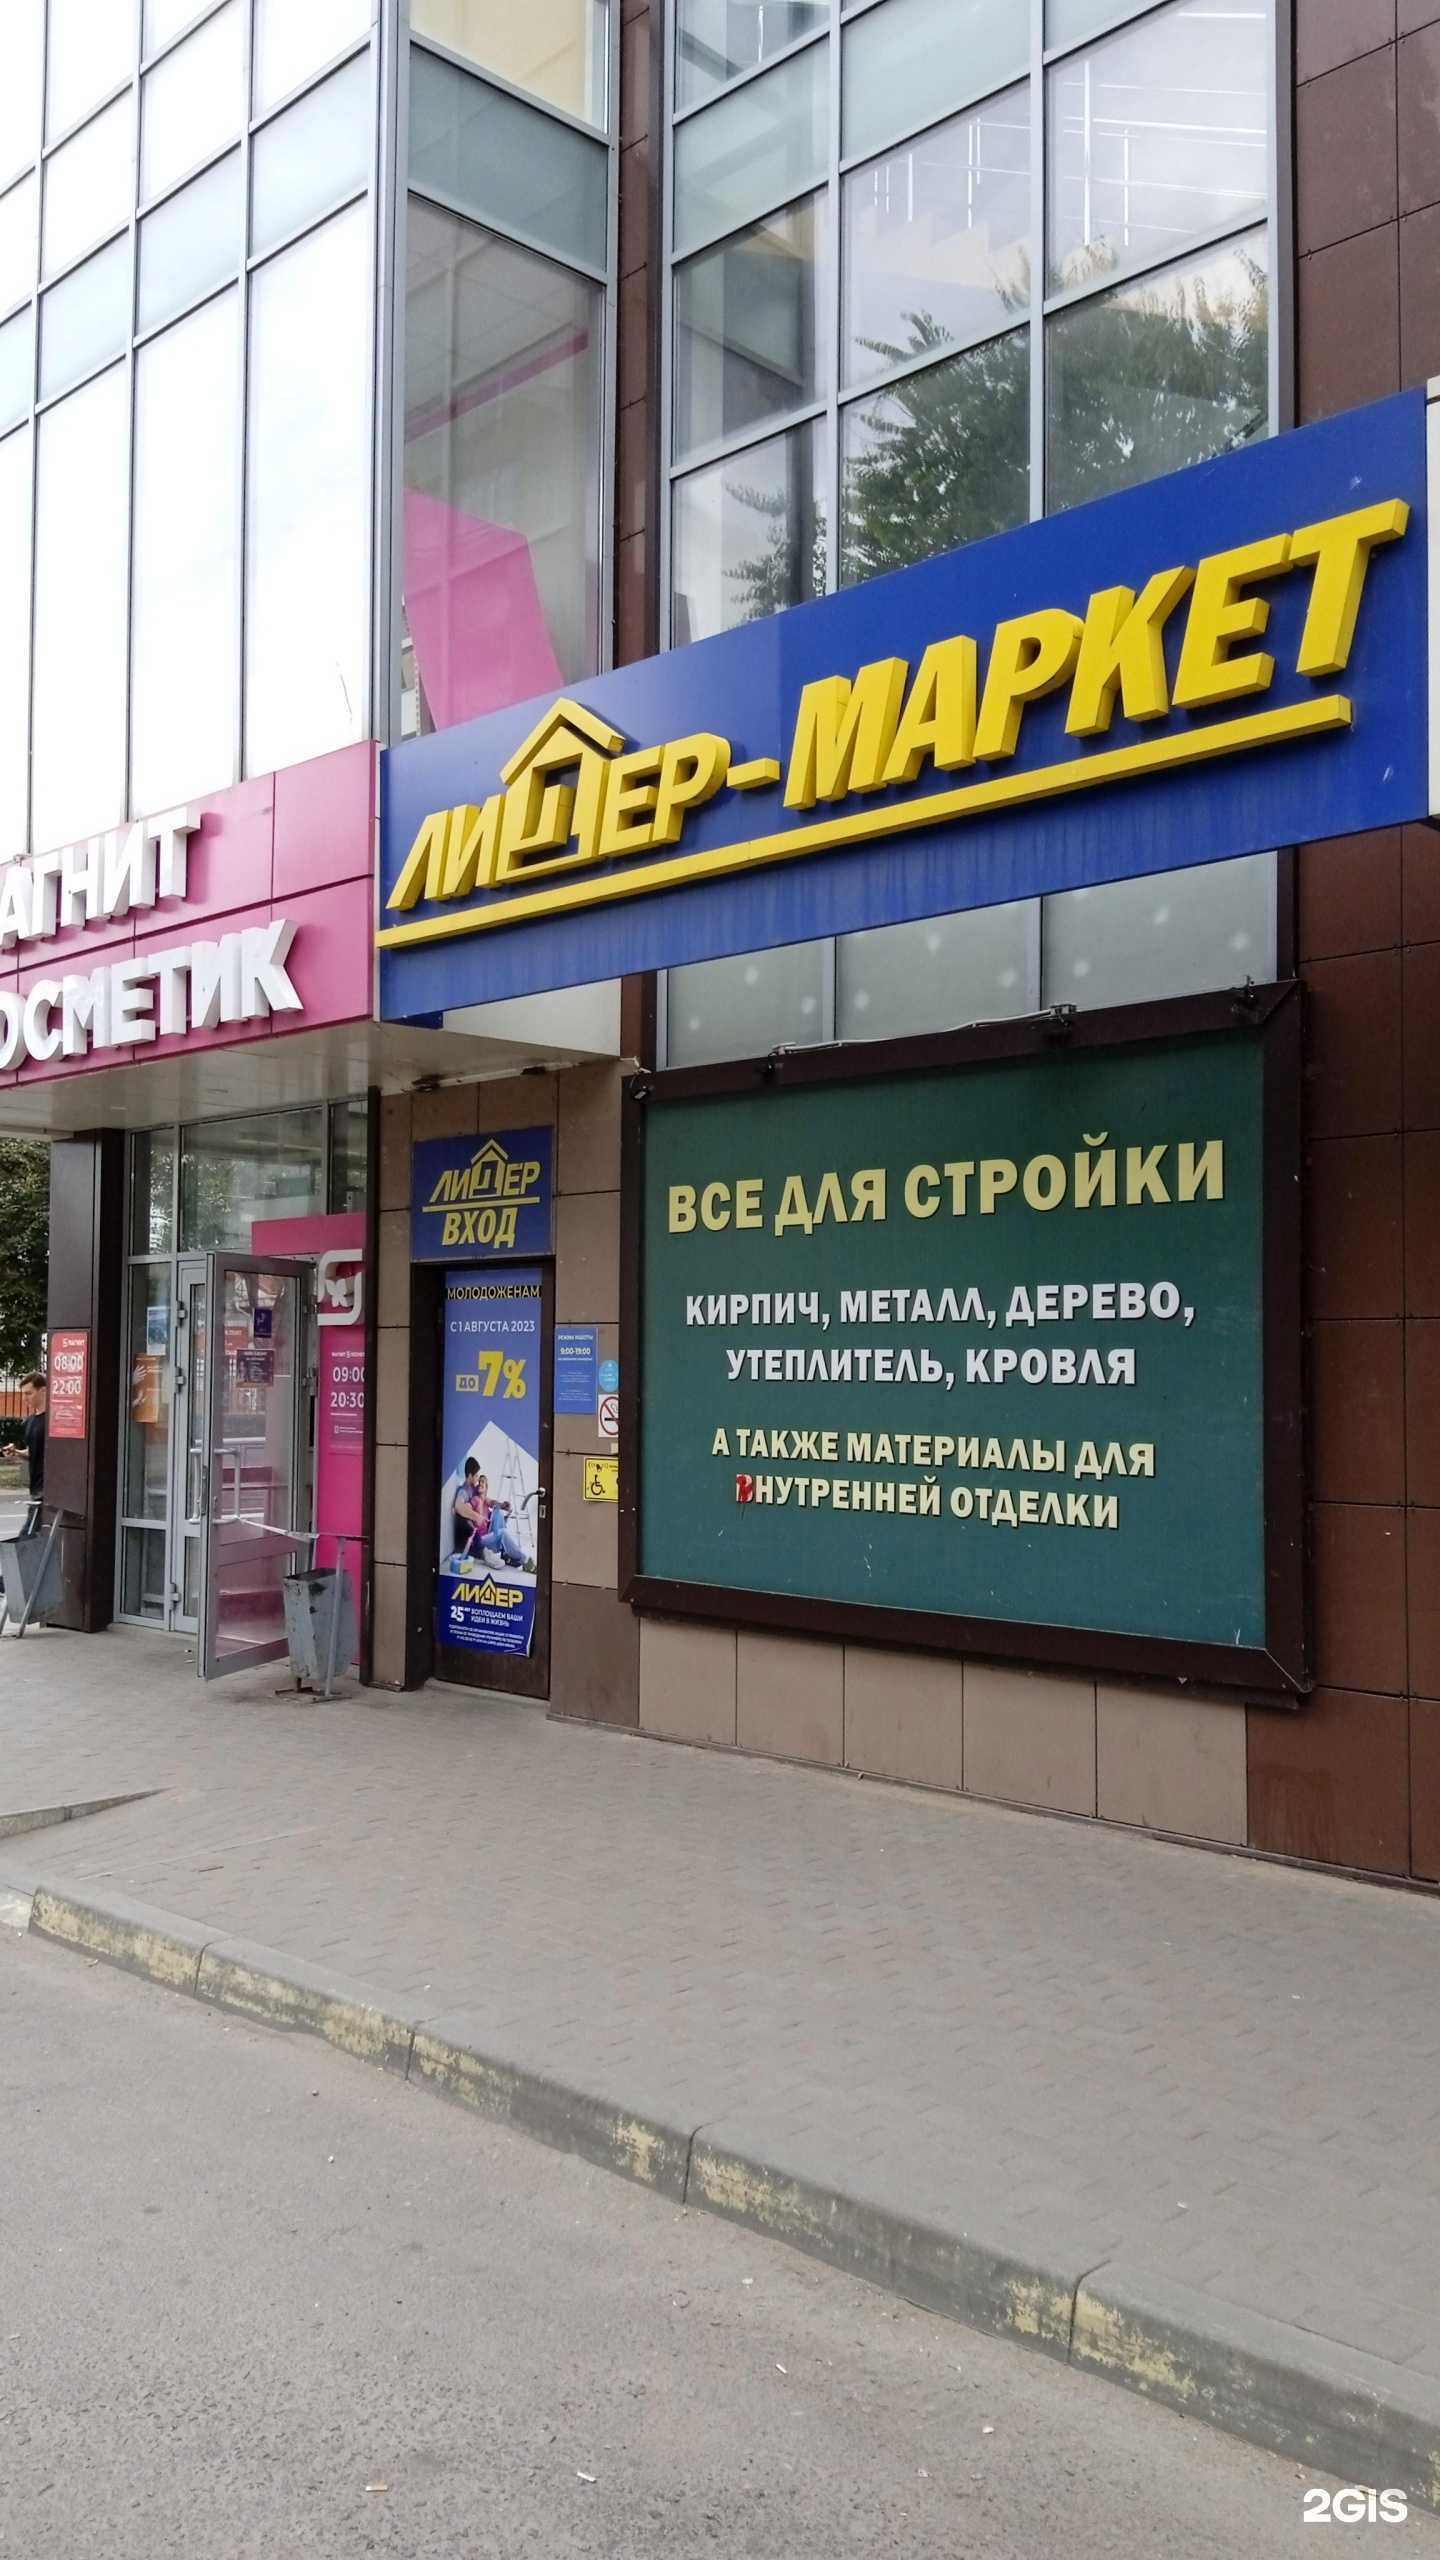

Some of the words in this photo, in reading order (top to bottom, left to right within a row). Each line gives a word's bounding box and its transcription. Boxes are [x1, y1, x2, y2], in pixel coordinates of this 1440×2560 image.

[429, 1139, 541, 1203] ЛИДЕР
[668, 1179, 764, 1233] ВСЕ
[774, 1168, 886, 1236] ДЛЯ
[904, 1132, 1225, 1218] СТРОЙКИ
[442, 1208, 518, 1248] ВХОД
[447, 1285, 540, 1301] МОЛОДОЖЕНАМ
[686, 1291, 831, 1330] КИРПИЧ,
[840, 1287, 997, 1329] МЕТАЛЛ,
[1005, 1281, 1196, 1328] ДЕРЕВО,
[464, 1320, 510, 1333] АВГУСТА
[511, 1320, 536, 1333] 2023
[54, 1354, 84, 1371] 08:00
[458, 1377, 477, 1390] ДО
[477, 1350, 527, 1399] 7%
[726, 1348, 954, 1391] УТЕПЛИТЕЛЬ,
[966, 1348, 1137, 1385] КРОВЛЯ
[330, 1391, 365, 1408] 20:30
[712, 1428, 730, 1456] А
[736, 1428, 839, 1462] ТАКЖЕ
[846, 1431, 1066, 1472] МАТЕРИАЛЫ
[1074, 1441, 1155, 1480] ДЛЯ
[735, 1473, 941, 1516] ВНУТРЕННЕЙ
[950, 1485, 1119, 1529] ОТДЕЛКИ
[450, 1605, 464, 1622] 25
[451, 1578, 523, 1608] ЛИДЕР
